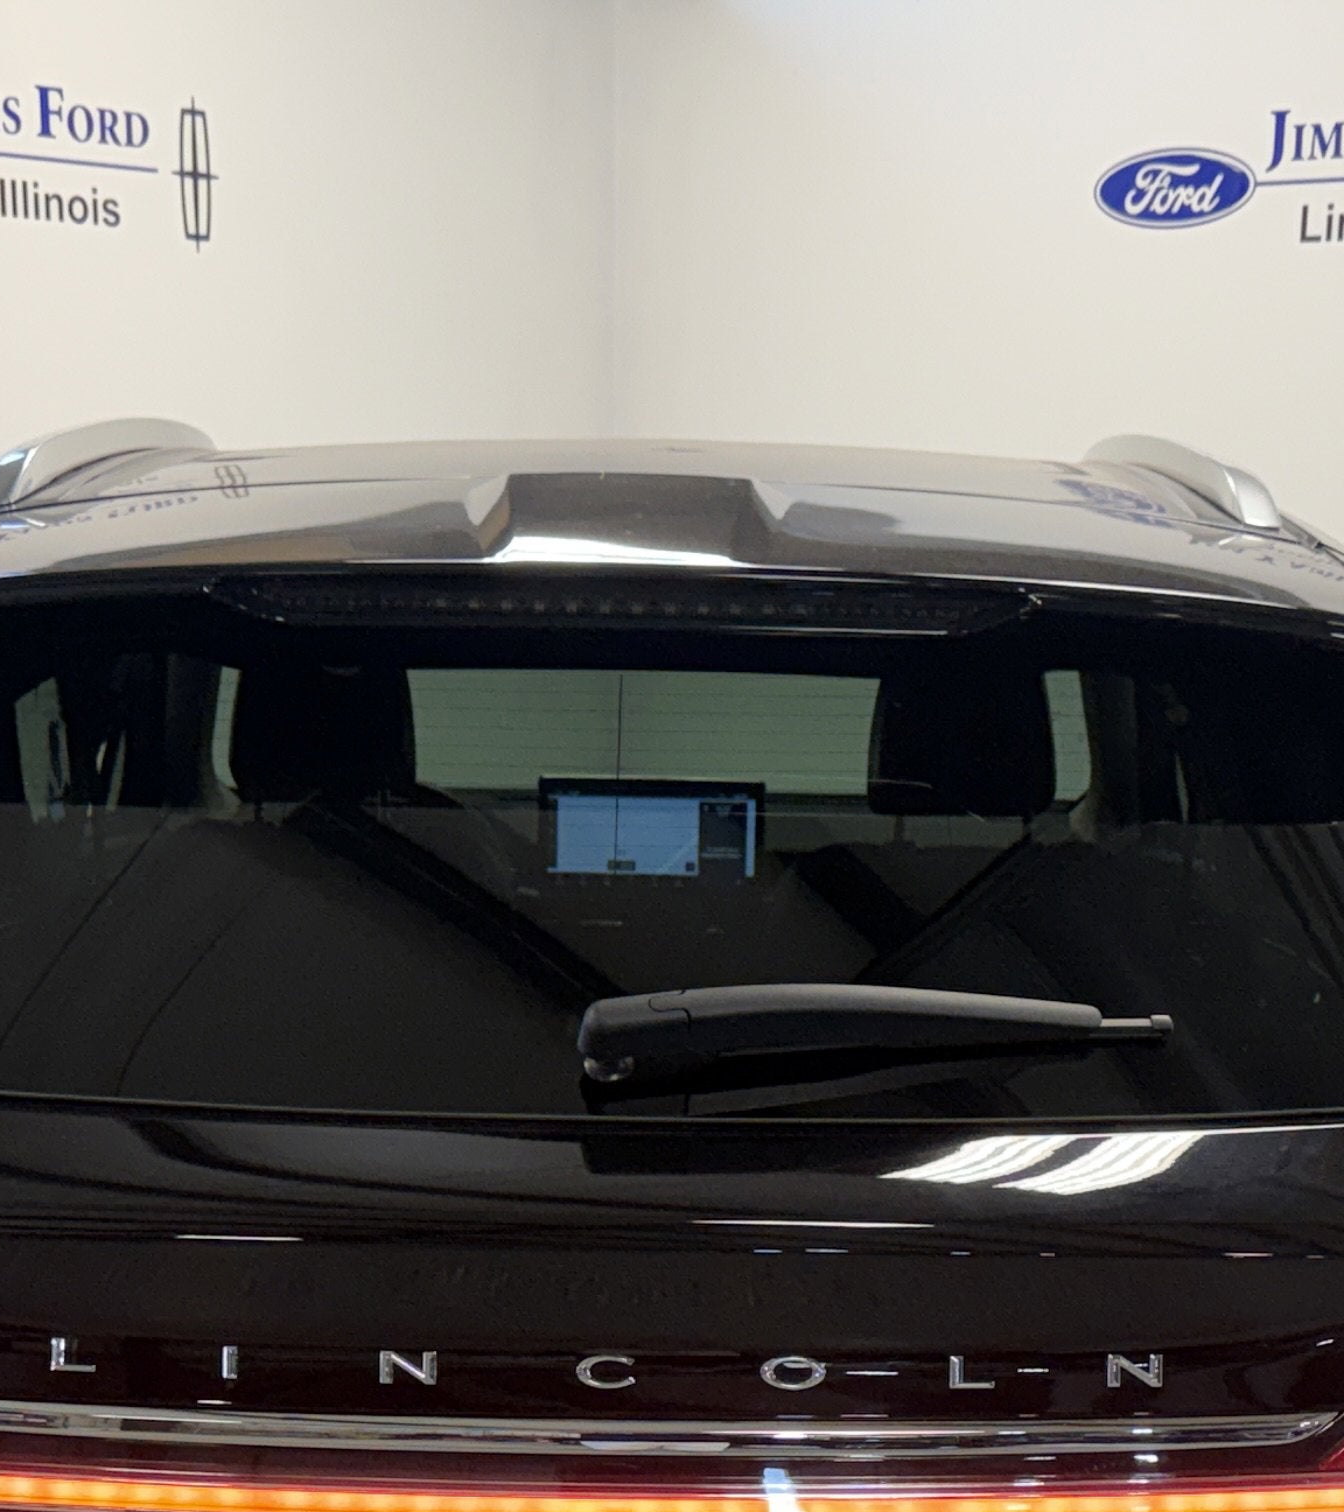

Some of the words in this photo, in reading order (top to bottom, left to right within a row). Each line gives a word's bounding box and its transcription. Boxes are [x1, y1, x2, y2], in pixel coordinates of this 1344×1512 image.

[35, 85, 150, 148] FORD
[1124, 161, 1221, 216] Ford
[50, 1337, 1164, 1389] LINCOLN
